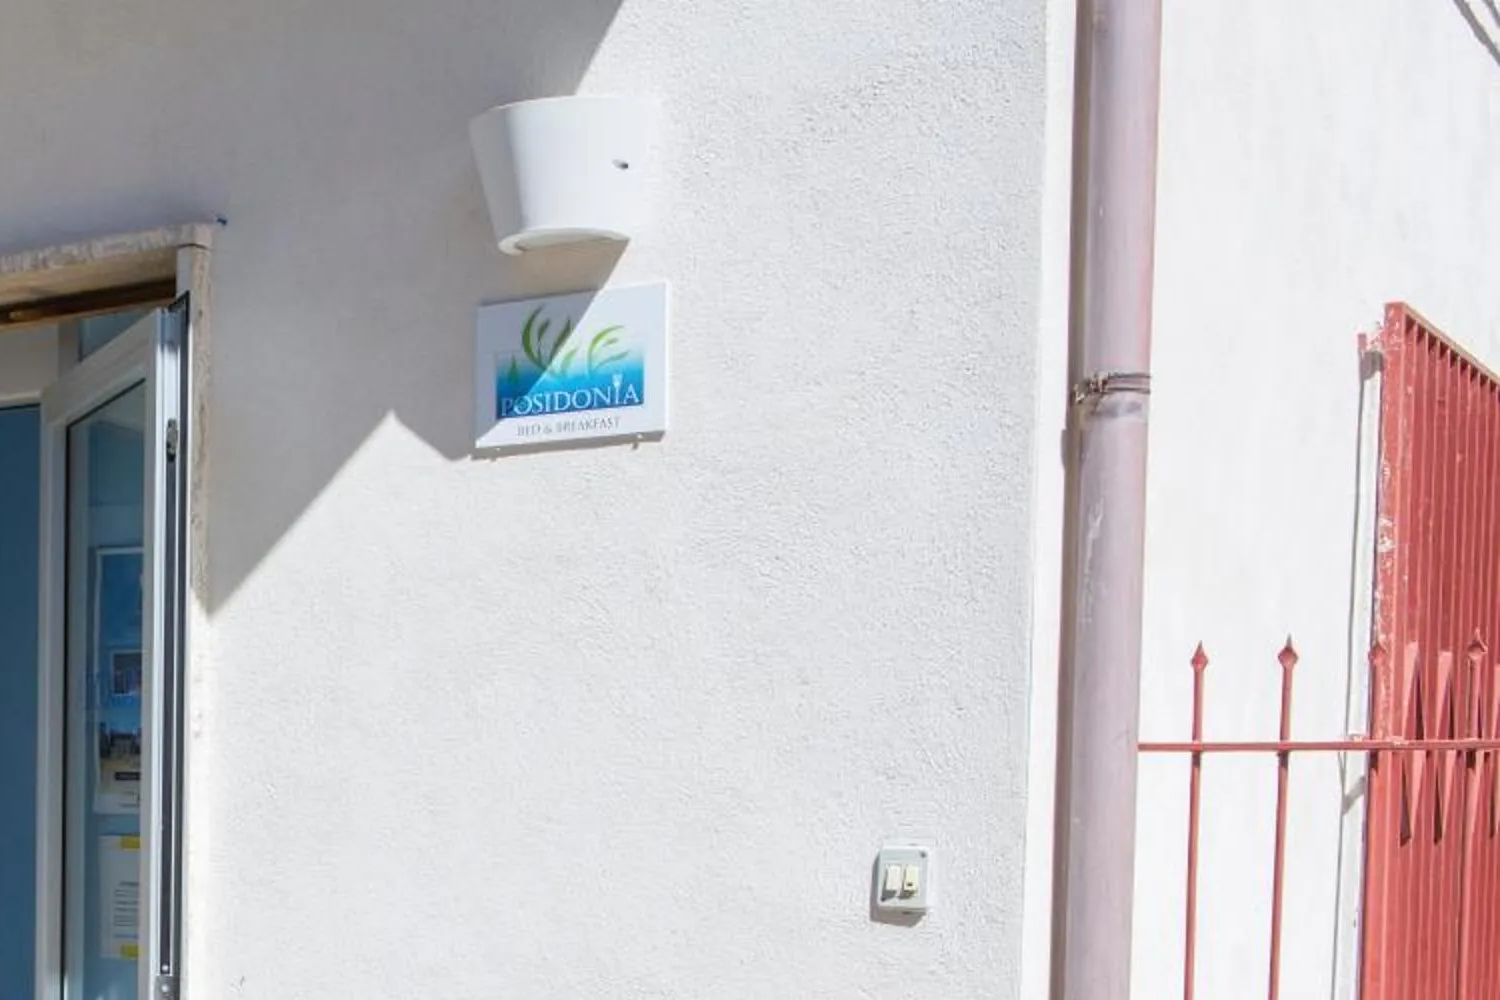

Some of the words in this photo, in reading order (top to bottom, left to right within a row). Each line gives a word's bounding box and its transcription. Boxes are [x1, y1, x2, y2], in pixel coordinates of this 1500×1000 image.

[501, 374, 640, 417] POSIDONIA
[516, 423, 541, 437] BED
[543, 424, 553, 434] &
[556, 416, 620, 433] BREAKFAST
